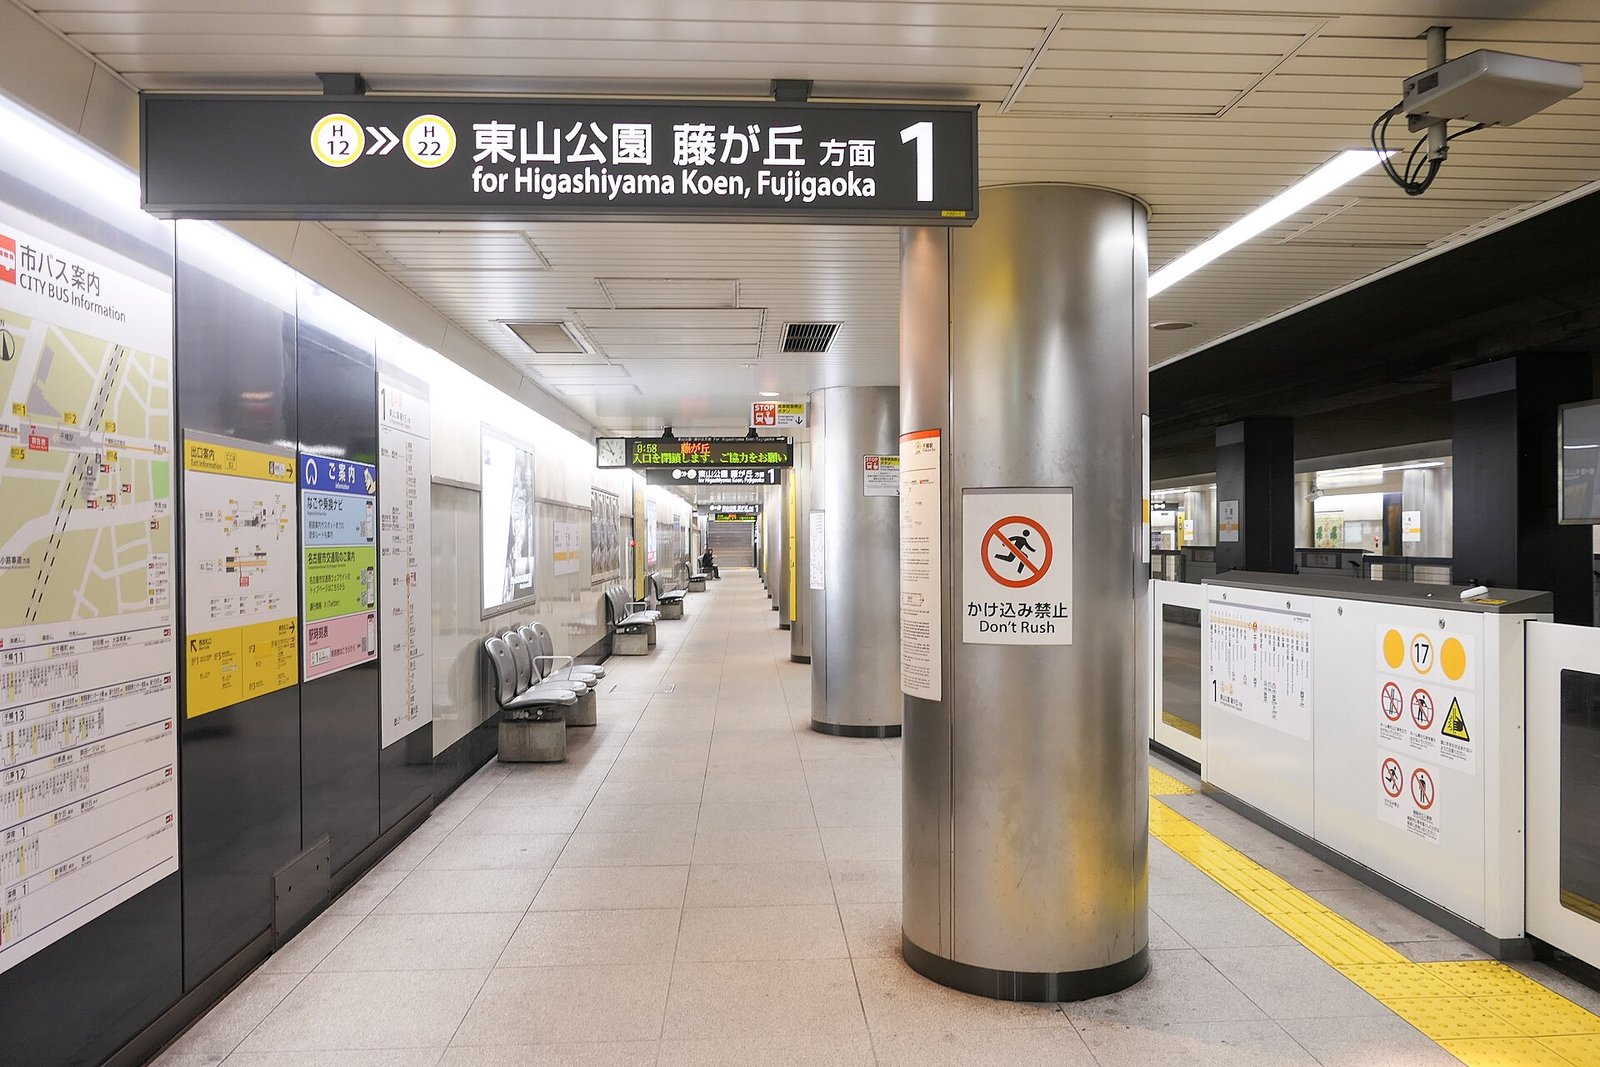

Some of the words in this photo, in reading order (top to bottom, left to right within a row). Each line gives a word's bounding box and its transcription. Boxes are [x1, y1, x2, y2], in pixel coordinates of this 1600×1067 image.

[332, 125, 343, 137] H
[424, 125, 435, 138] H
[327, 140, 350, 155] 12
[417, 141, 441, 156] 22
[472, 120, 653, 165] 東山公園
[672, 122, 806, 166] 藤が丘
[819, 139, 876, 167] 方面
[899, 121, 933, 202] 1
[472, 165, 508, 193] for
[514, 167, 678, 201] Higashiyama
[682, 170, 751, 199] Koen,
[757, 170, 876, 203] Fujigaoka
[20, 245, 100, 297] 市バス案内
[20, 273, 46, 295] CITY
[48, 283, 69, 303] BUS
[71, 291, 126, 323] Information
[680, 443, 711, 454] 藤が丘
[329, 462, 355, 484] ご案内
[768, 469, 775, 484] 1
[968, 602, 1068, 618] かけ込み禁止
[979, 620, 1017, 633] Don't
[1021, 621, 1055, 634] Rush
[1414, 642, 1430, 664] 17
[1212, 679, 1217, 702] 1
